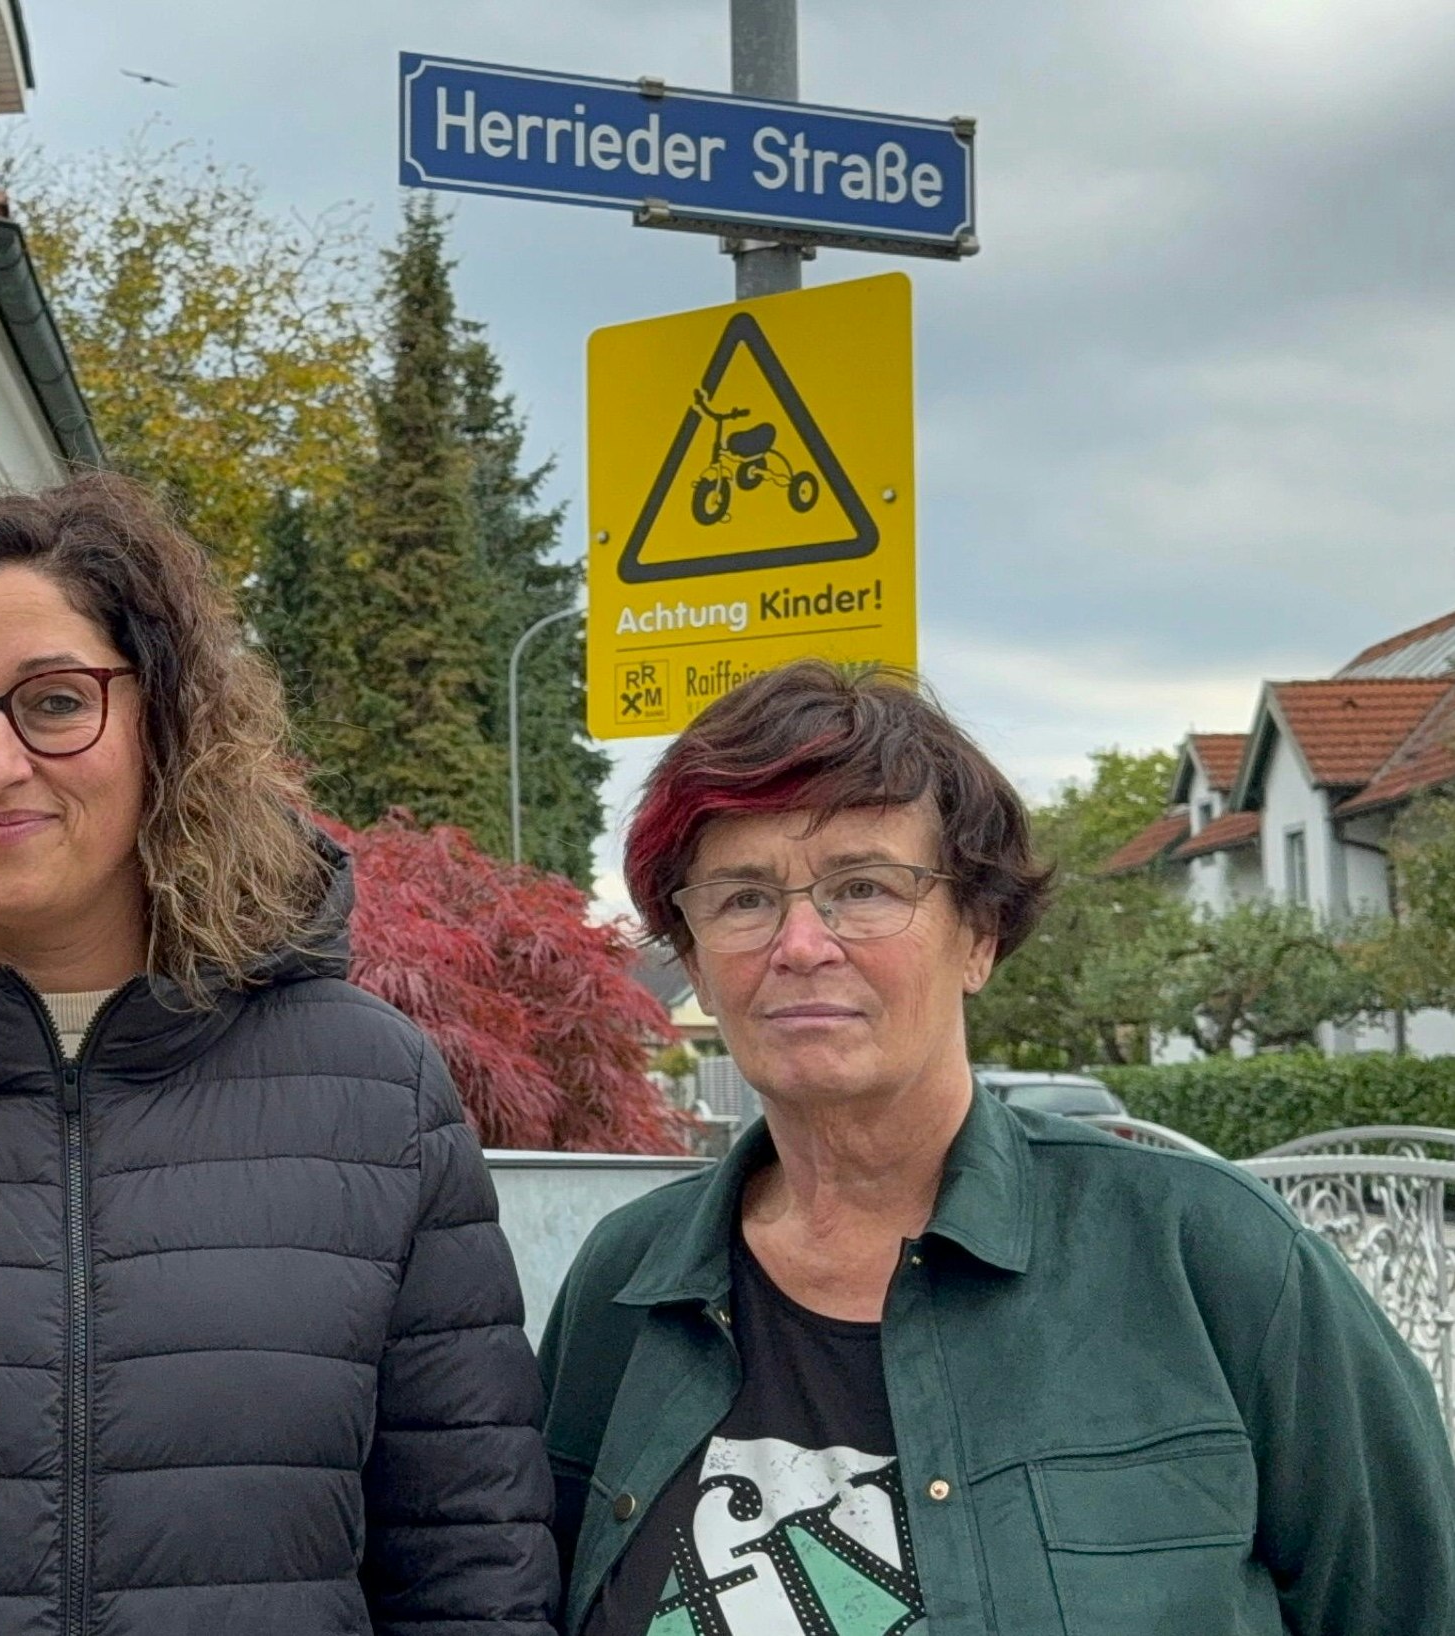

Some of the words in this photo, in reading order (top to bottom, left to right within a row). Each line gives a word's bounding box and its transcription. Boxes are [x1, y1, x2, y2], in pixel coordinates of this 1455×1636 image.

[435, 85, 726, 183] Herrieder
[751, 126, 944, 209] Straße
[615, 598, 749, 636] Achtung
[759, 579, 882, 621] Kinder!
